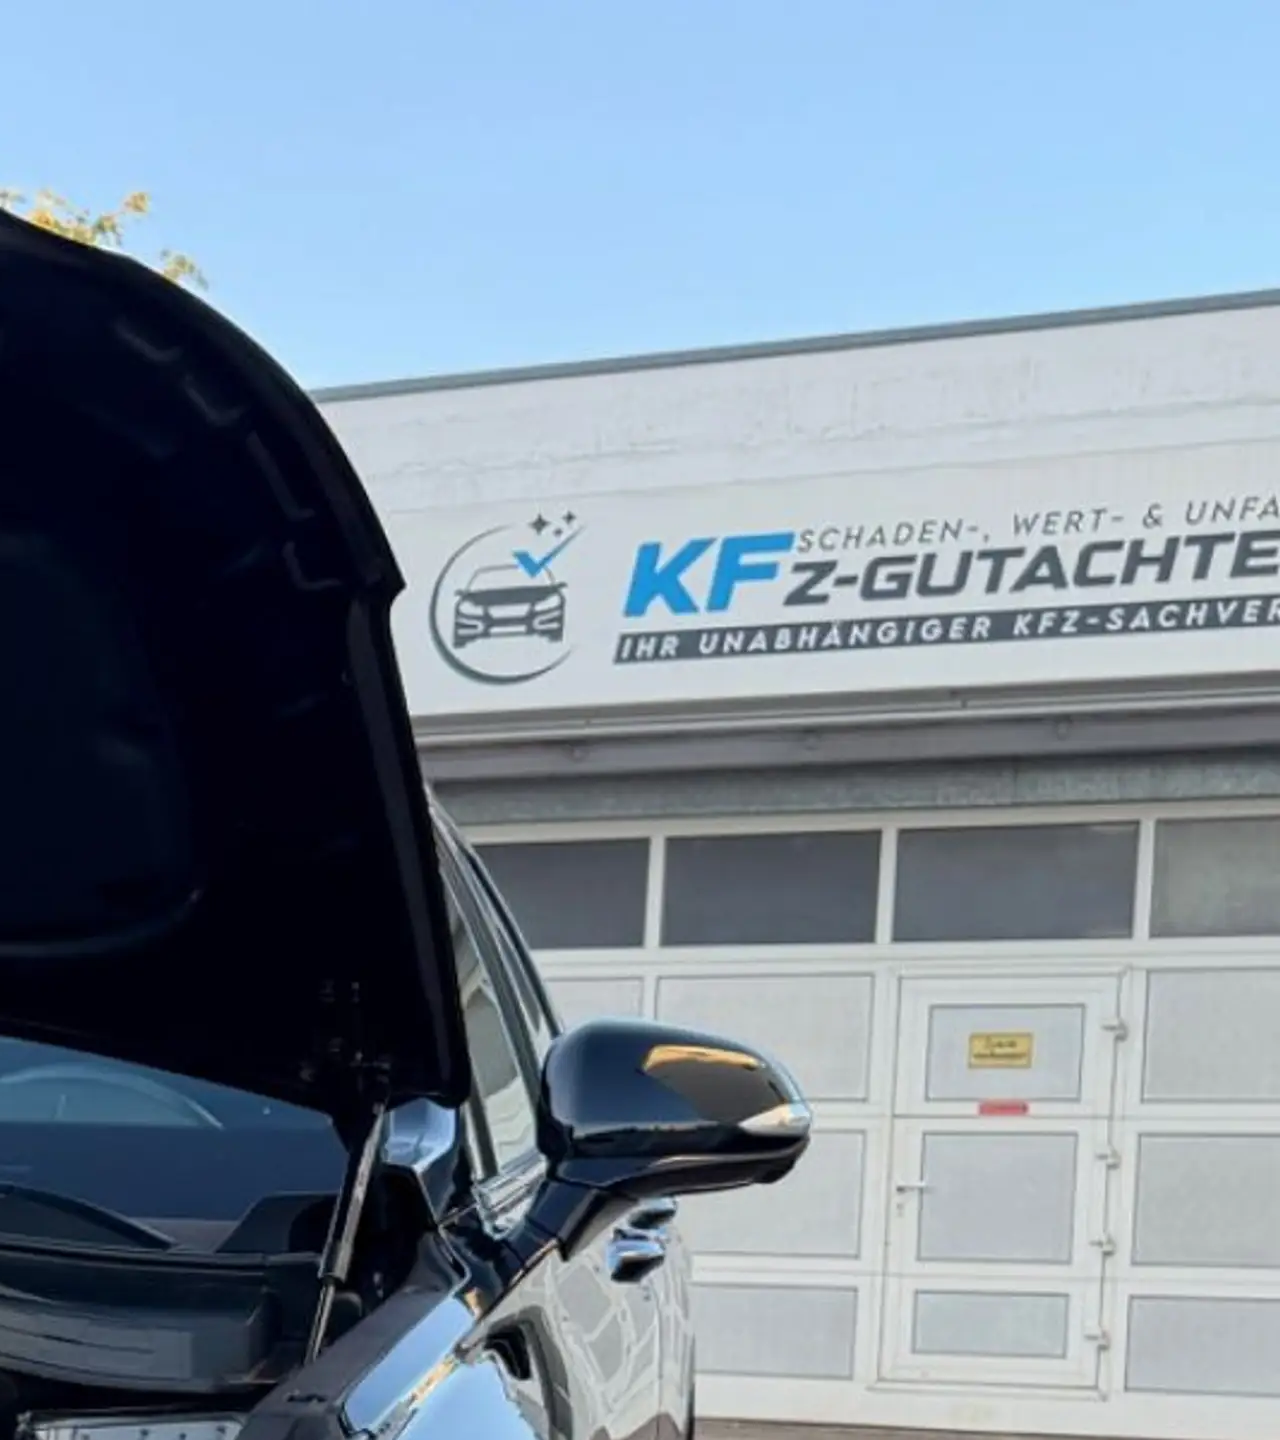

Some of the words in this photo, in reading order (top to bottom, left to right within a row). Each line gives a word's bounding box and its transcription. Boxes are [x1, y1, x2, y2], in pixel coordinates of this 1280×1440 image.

[796, 517, 990, 553] SCHADEN-,
[1013, 506, 1125, 537] WERT-
[1142, 502, 1165, 530] &
[1185, 495, 1280, 526] UNFA
[620, 634, 681, 660] IHR
[698, 615, 991, 656] UNABHÄNGIGER
